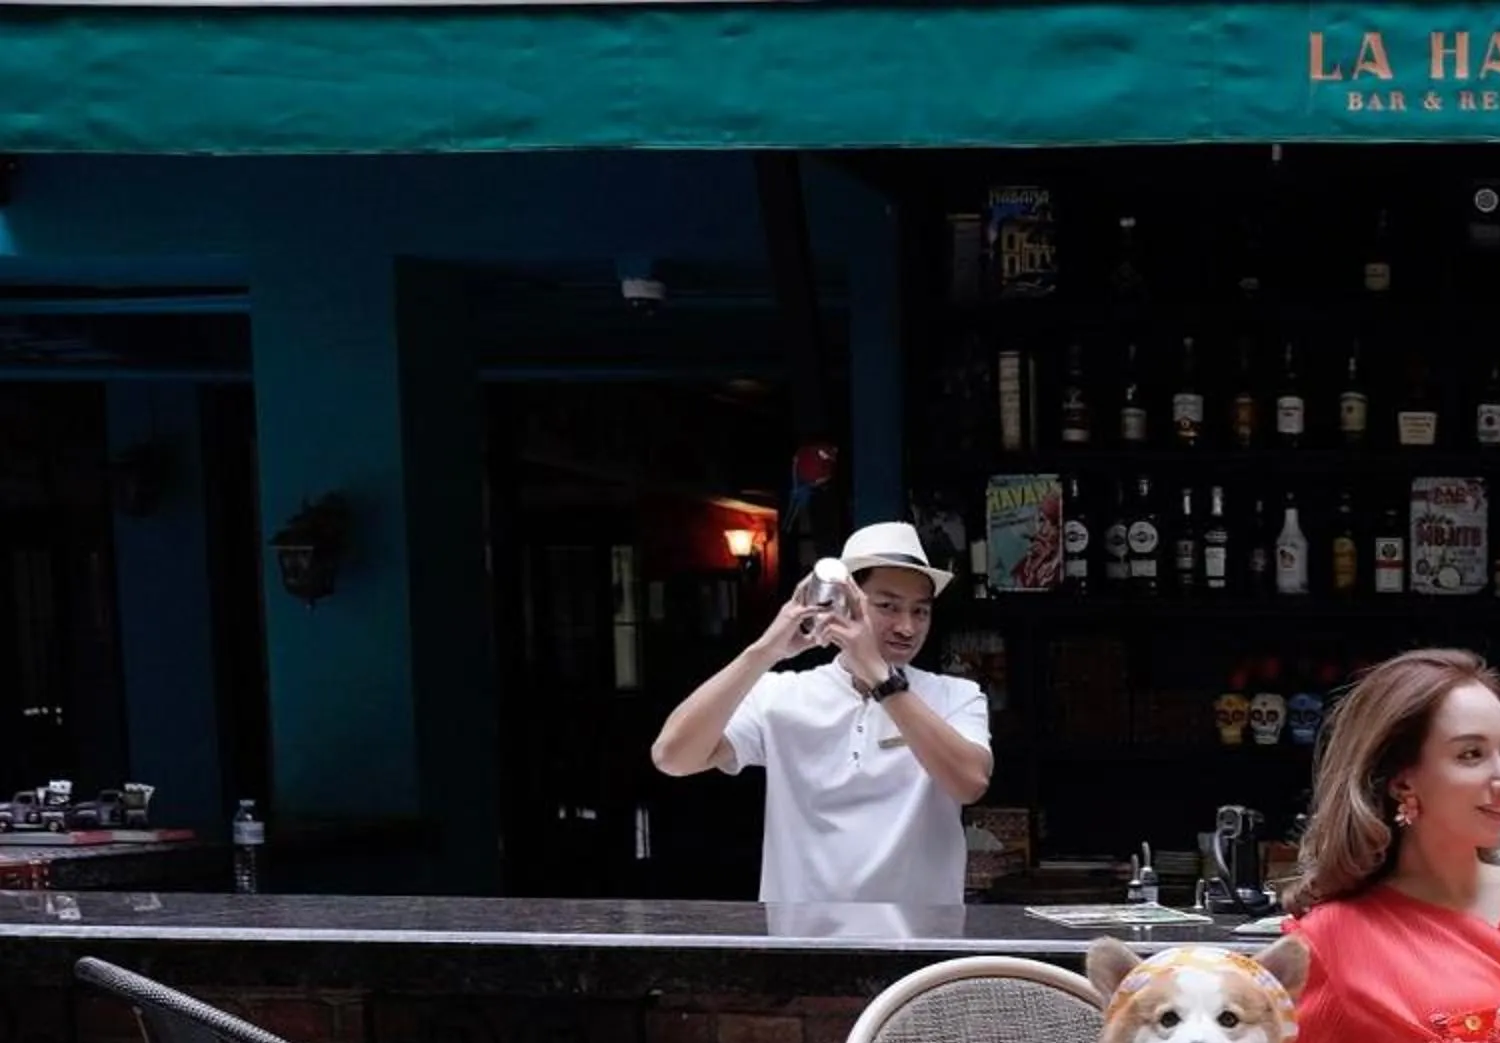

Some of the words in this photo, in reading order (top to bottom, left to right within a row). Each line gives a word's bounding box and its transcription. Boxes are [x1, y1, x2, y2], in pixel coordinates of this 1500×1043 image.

[1309, 31, 1393, 80] LA
[1347, 91, 1407, 111] BAR
[1423, 92, 1442, 111] &
